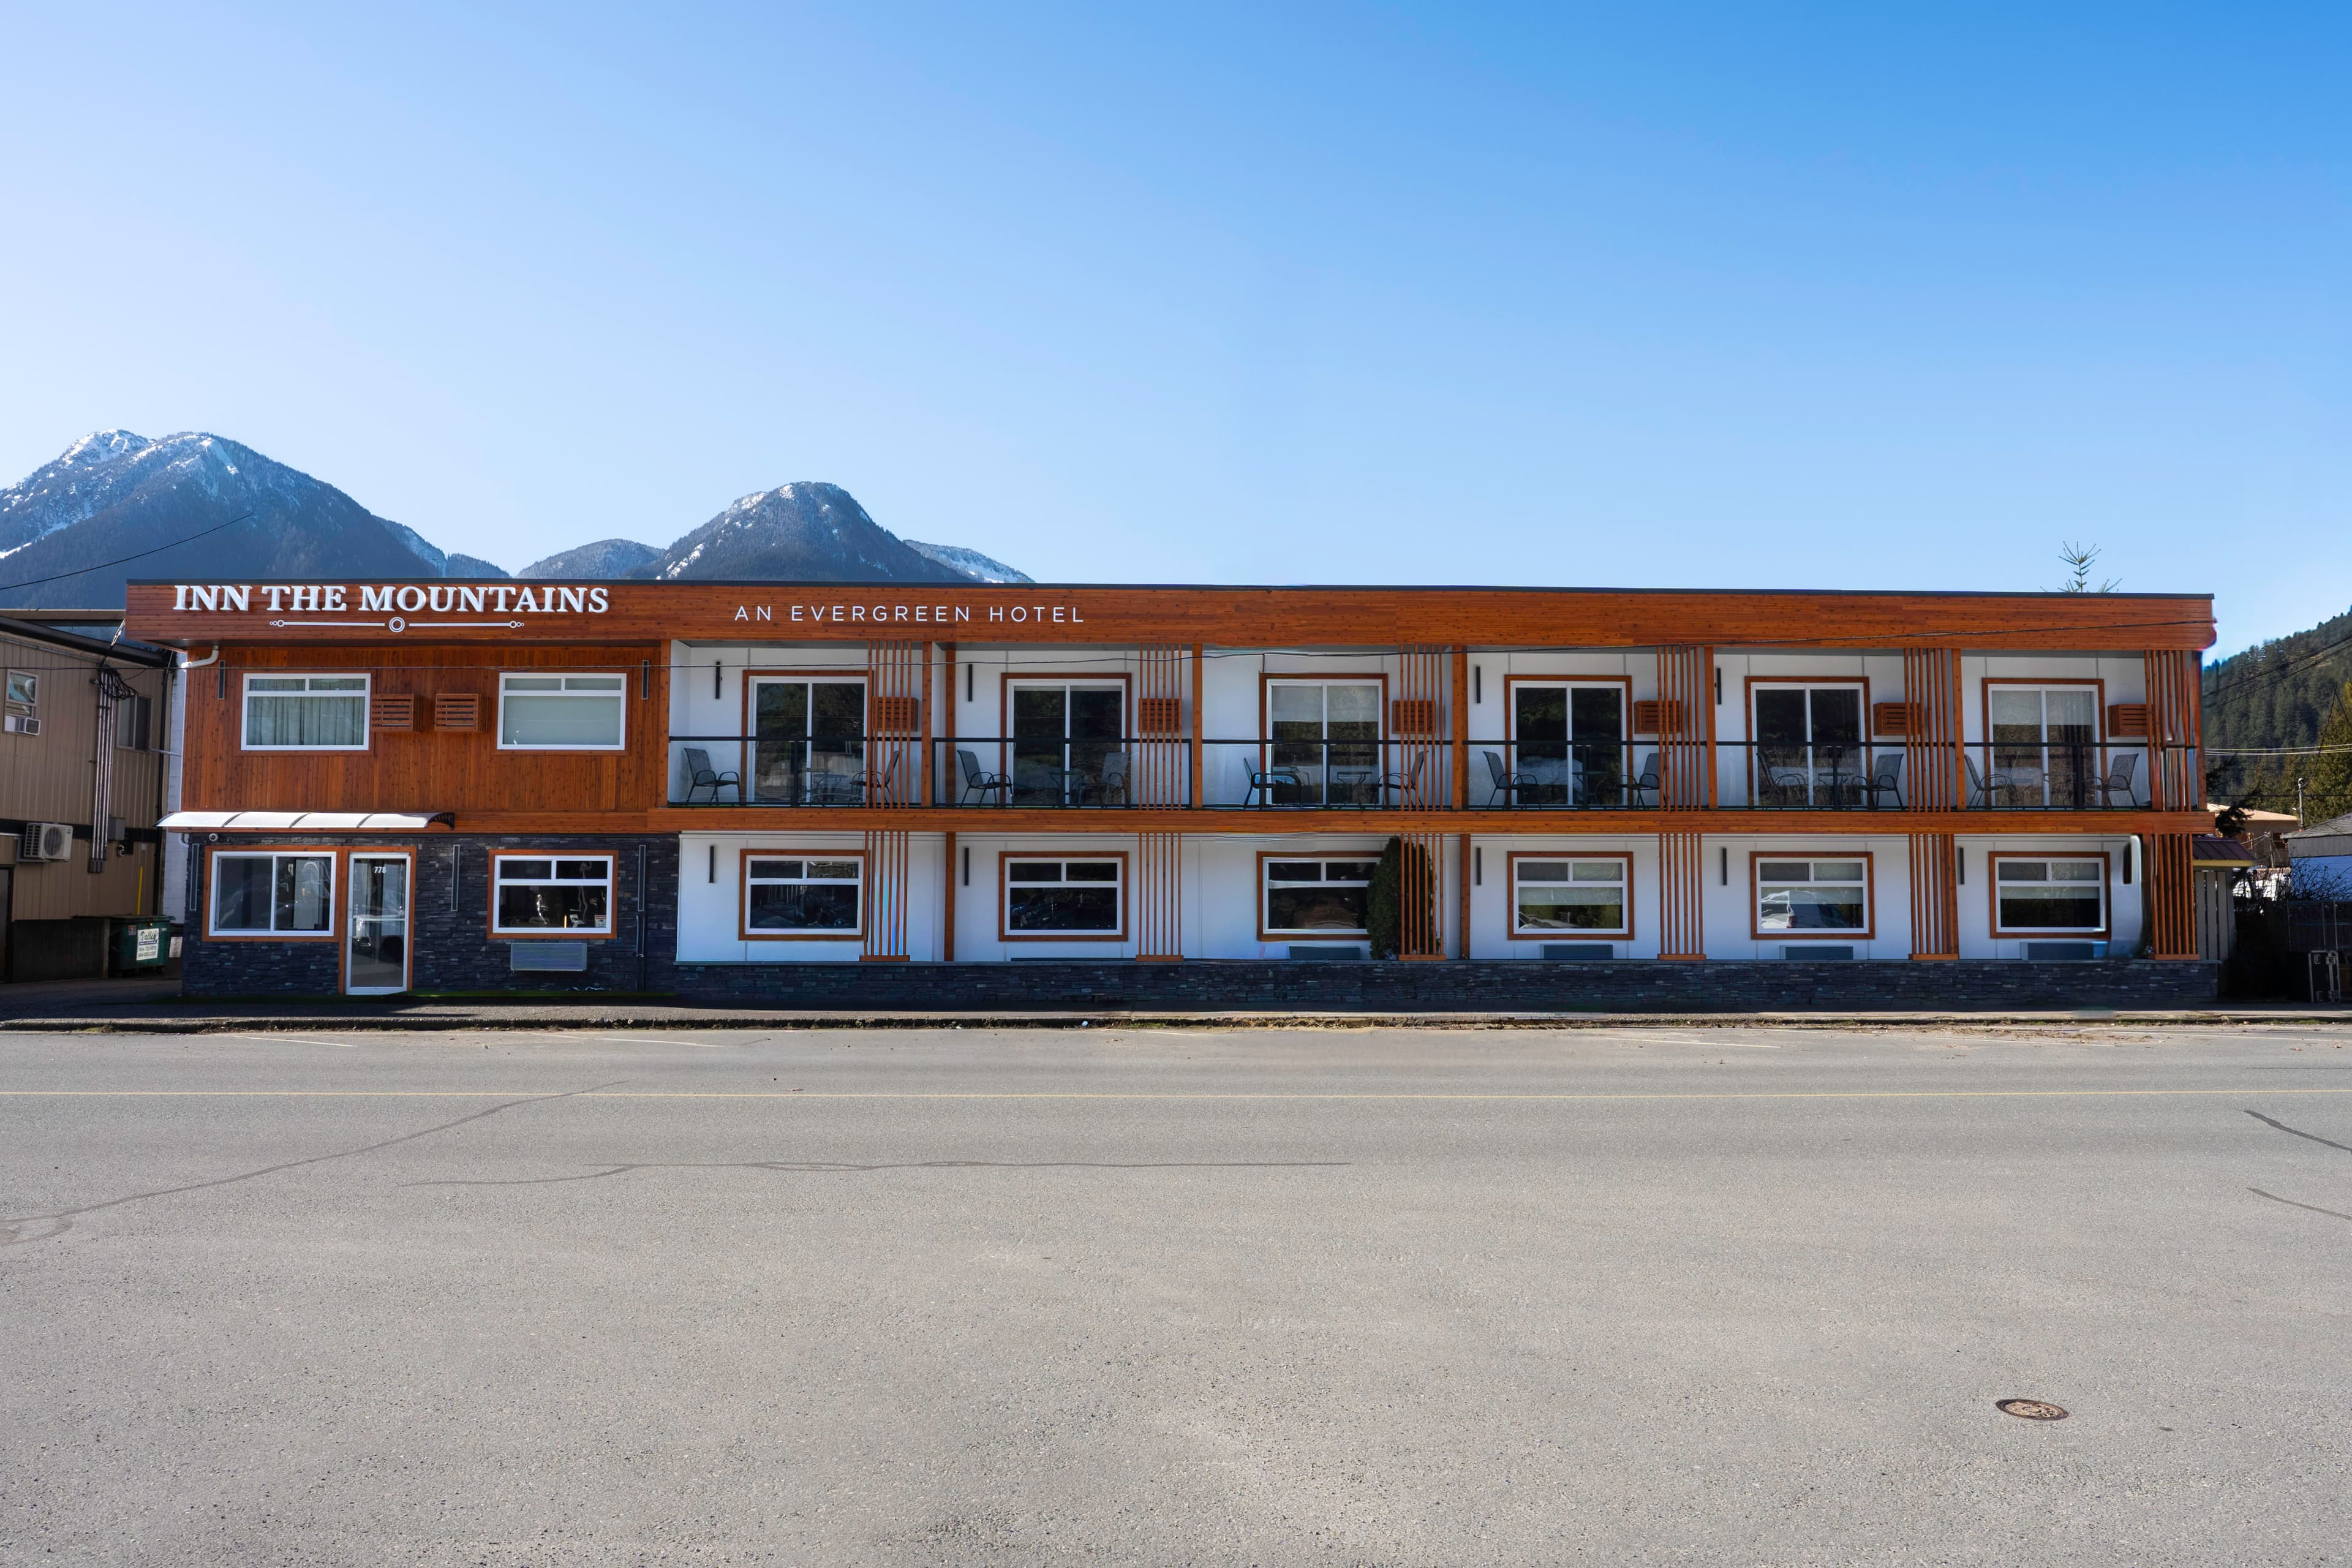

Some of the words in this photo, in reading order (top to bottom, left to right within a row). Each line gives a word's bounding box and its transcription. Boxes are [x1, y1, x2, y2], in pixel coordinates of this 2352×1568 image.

[173, 585, 252, 611] INN
[262, 586, 347, 611] THE
[358, 586, 609, 612] MOUNTAINS
[734, 605, 771, 621] AN
[791, 606, 969, 622] EVERGREEN
[990, 606, 1084, 622] HOTEL
